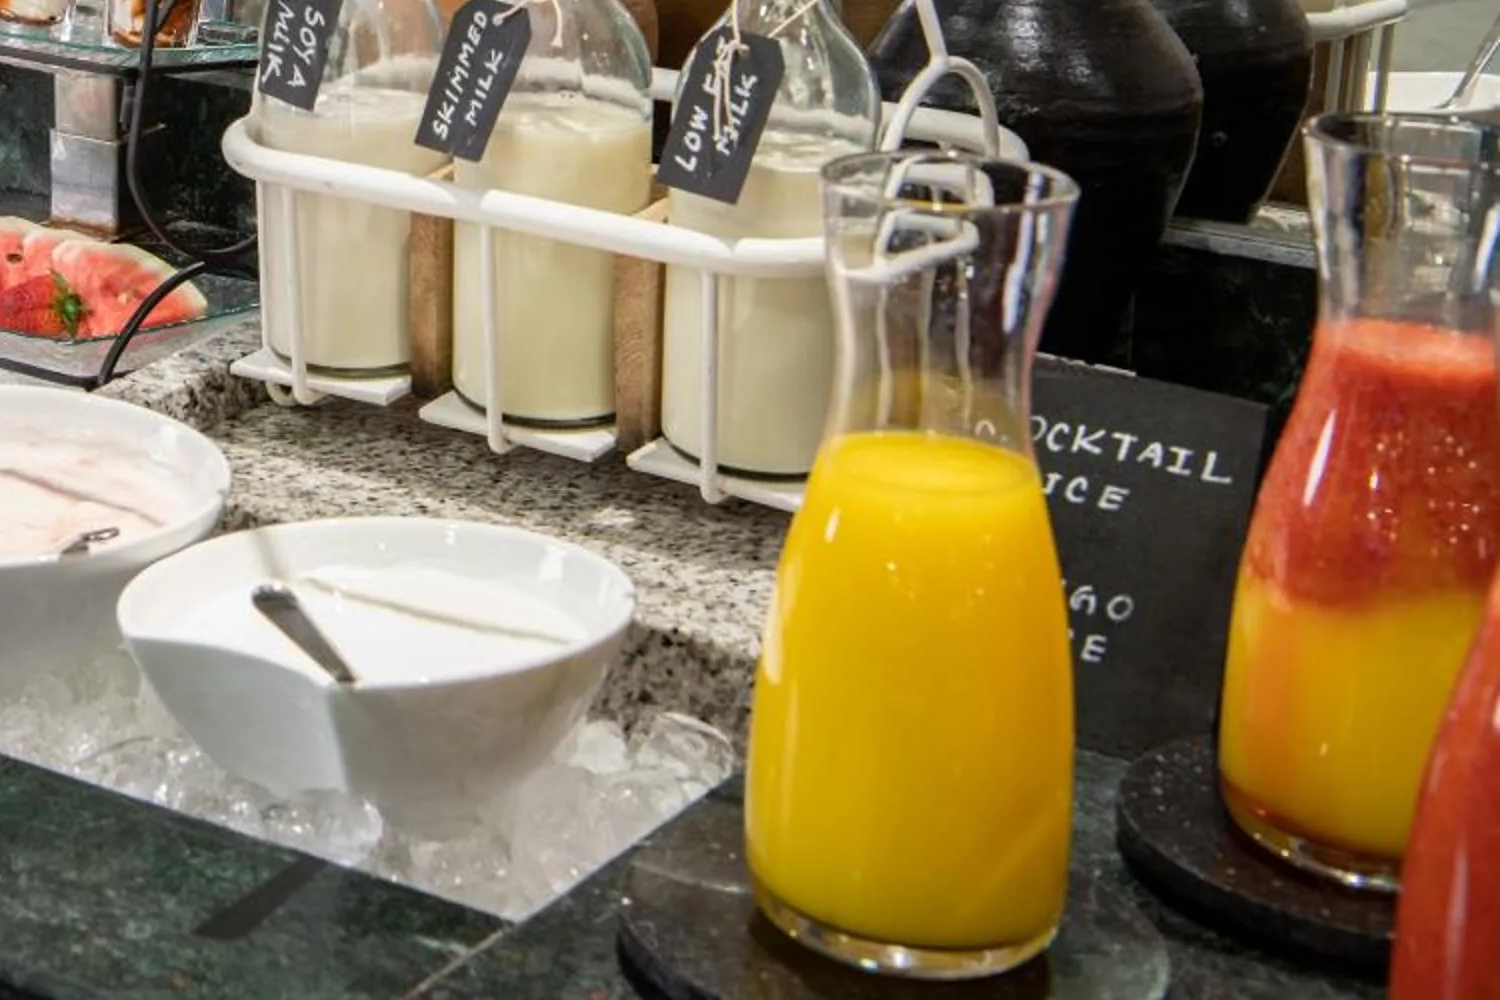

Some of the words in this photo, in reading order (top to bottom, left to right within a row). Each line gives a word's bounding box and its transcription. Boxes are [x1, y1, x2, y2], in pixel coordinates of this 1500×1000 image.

[286, 5, 326, 88] SOYA
[431, 10, 488, 141] SKIMMED
[464, 48, 504, 127] MILK
[674, 105, 709, 172] LOW
[1041, 472, 1131, 510] ICE
